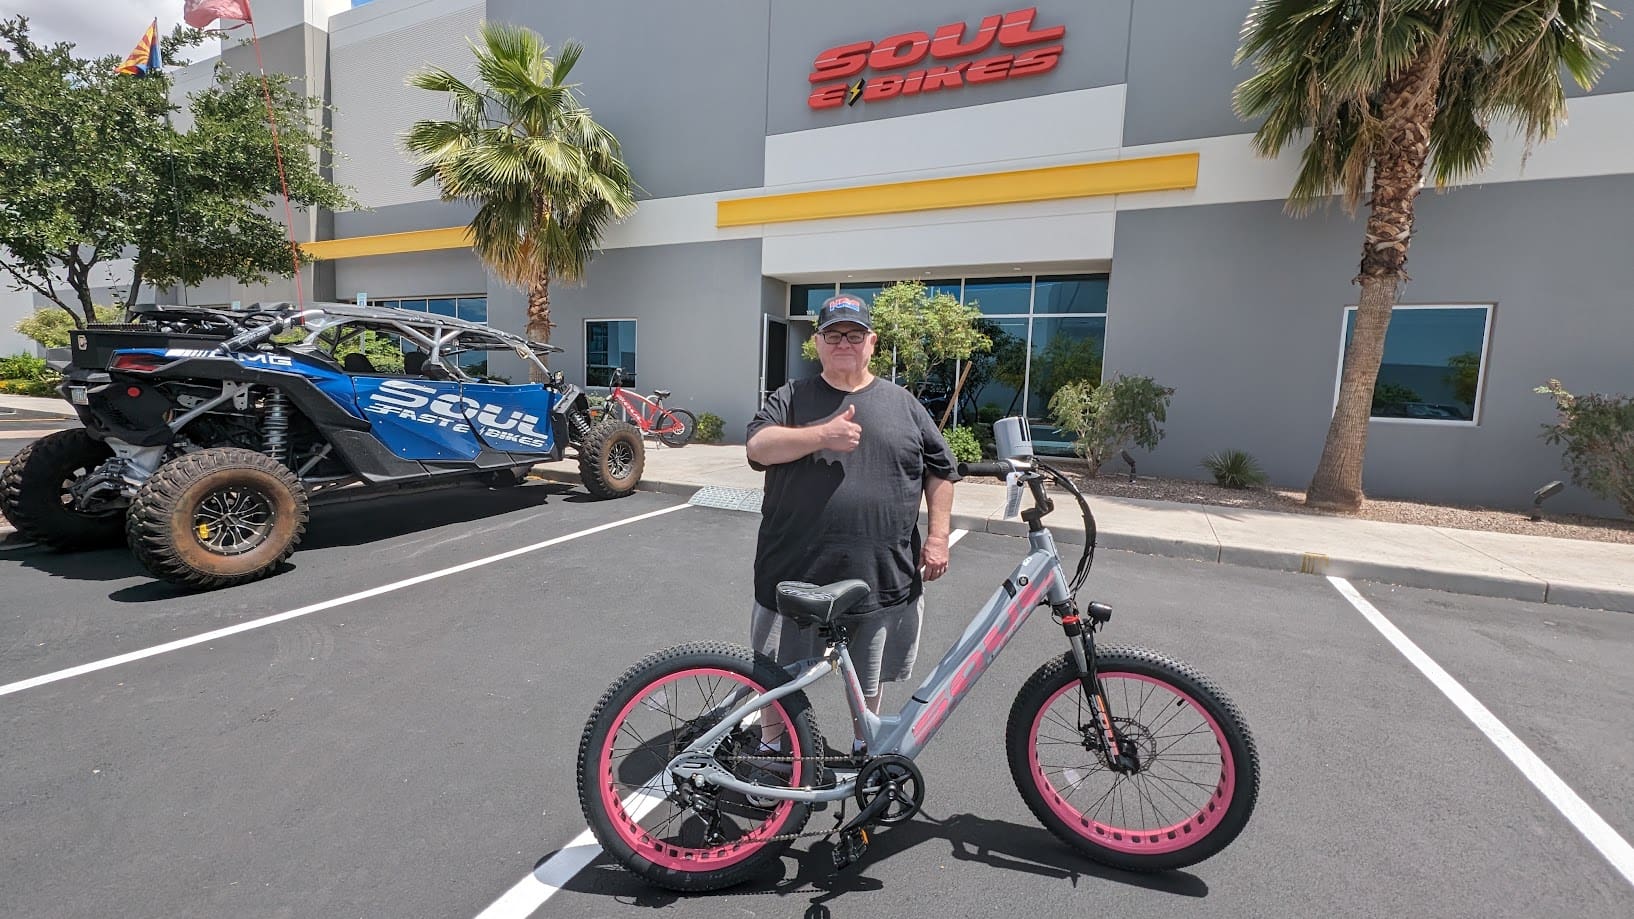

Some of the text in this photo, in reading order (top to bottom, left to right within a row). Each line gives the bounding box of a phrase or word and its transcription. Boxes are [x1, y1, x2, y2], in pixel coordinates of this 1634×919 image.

[809, 7, 1065, 83] SOUL
[369, 380, 548, 440] SOUL
[912, 570, 1056, 744] SOUL
[1092, 694, 1120, 764] SOUL
